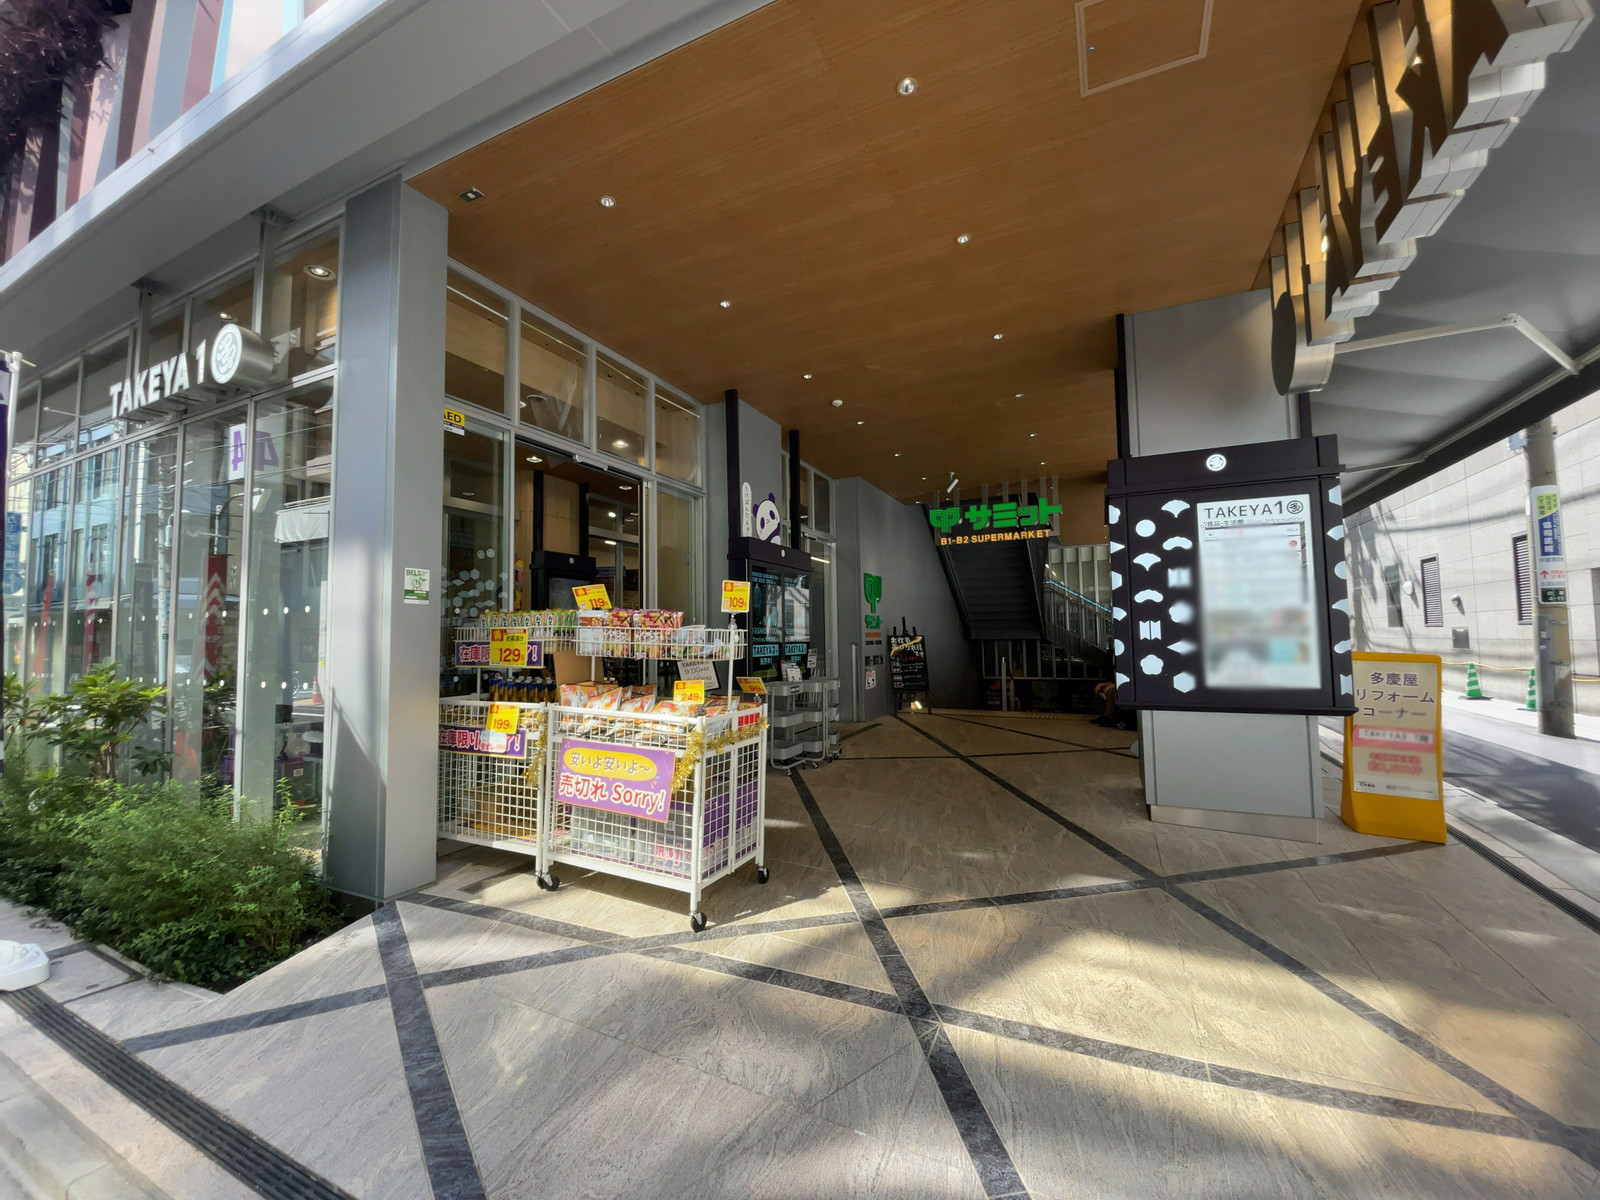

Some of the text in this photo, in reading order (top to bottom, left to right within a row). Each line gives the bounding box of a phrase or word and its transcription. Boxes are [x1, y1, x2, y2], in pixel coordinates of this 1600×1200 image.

[110, 352, 190, 418] TAKEYA
[965, 498, 1062, 531] サミット
[940, 529, 1051, 546] B1-B2 SUPERMARKET
[1370, 672, 1419, 687] 多慶屋
[1356, 688, 1435, 704] リフォーム
[1363, 706, 1427, 719] コーナー
[559, 773, 666, 814] 売切れ Sorry!
